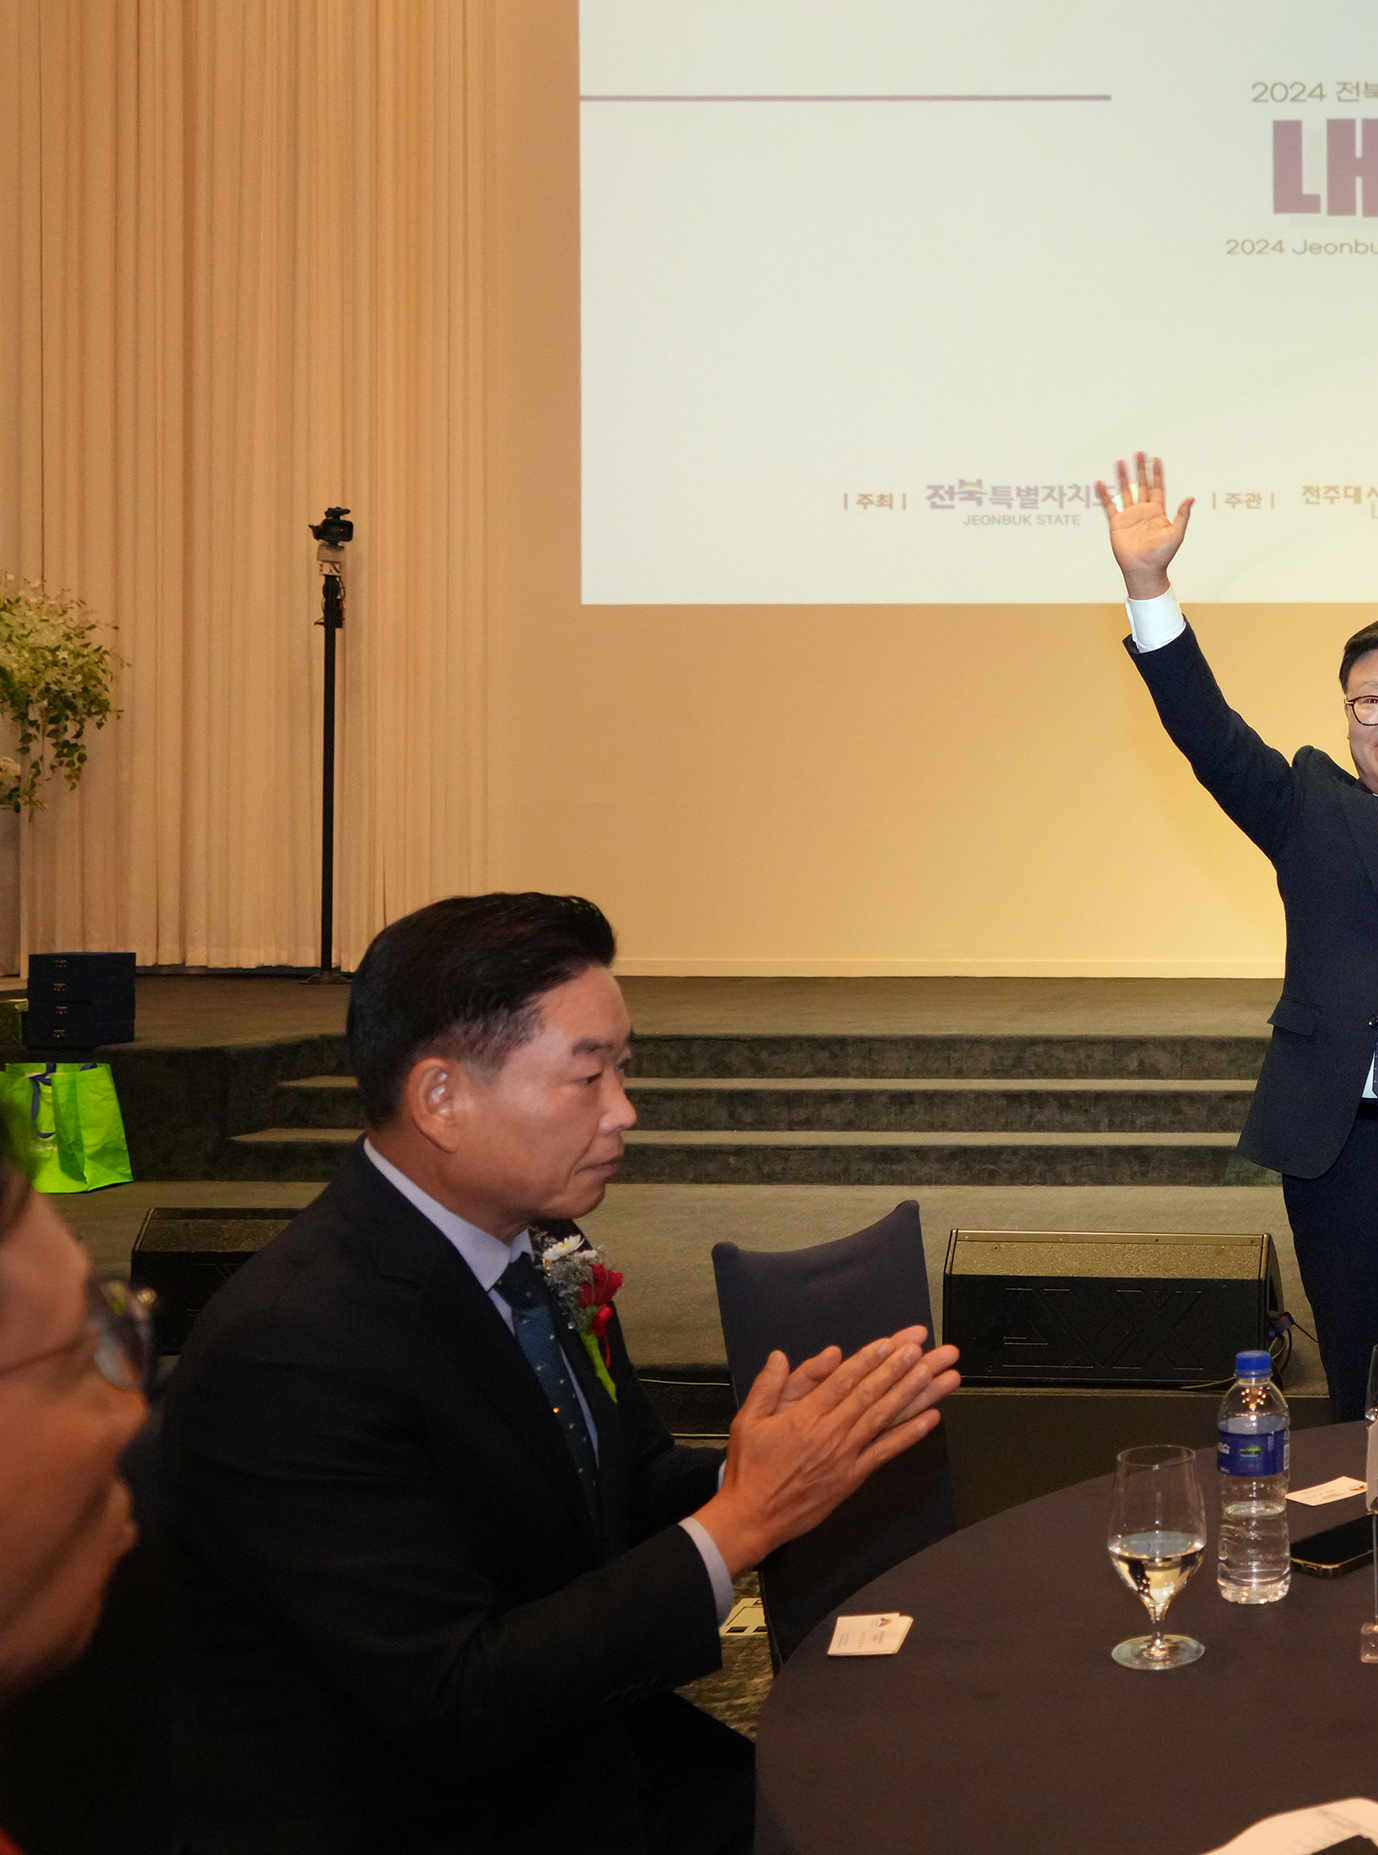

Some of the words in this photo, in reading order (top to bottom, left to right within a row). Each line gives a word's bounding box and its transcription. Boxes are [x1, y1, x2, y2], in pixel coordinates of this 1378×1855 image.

[1250, 81, 1327, 102] 2024
[1225, 239, 1286, 256] 2024
[962, 514, 1032, 527] JEONBUK
[1036, 514, 1082, 526] STATE
